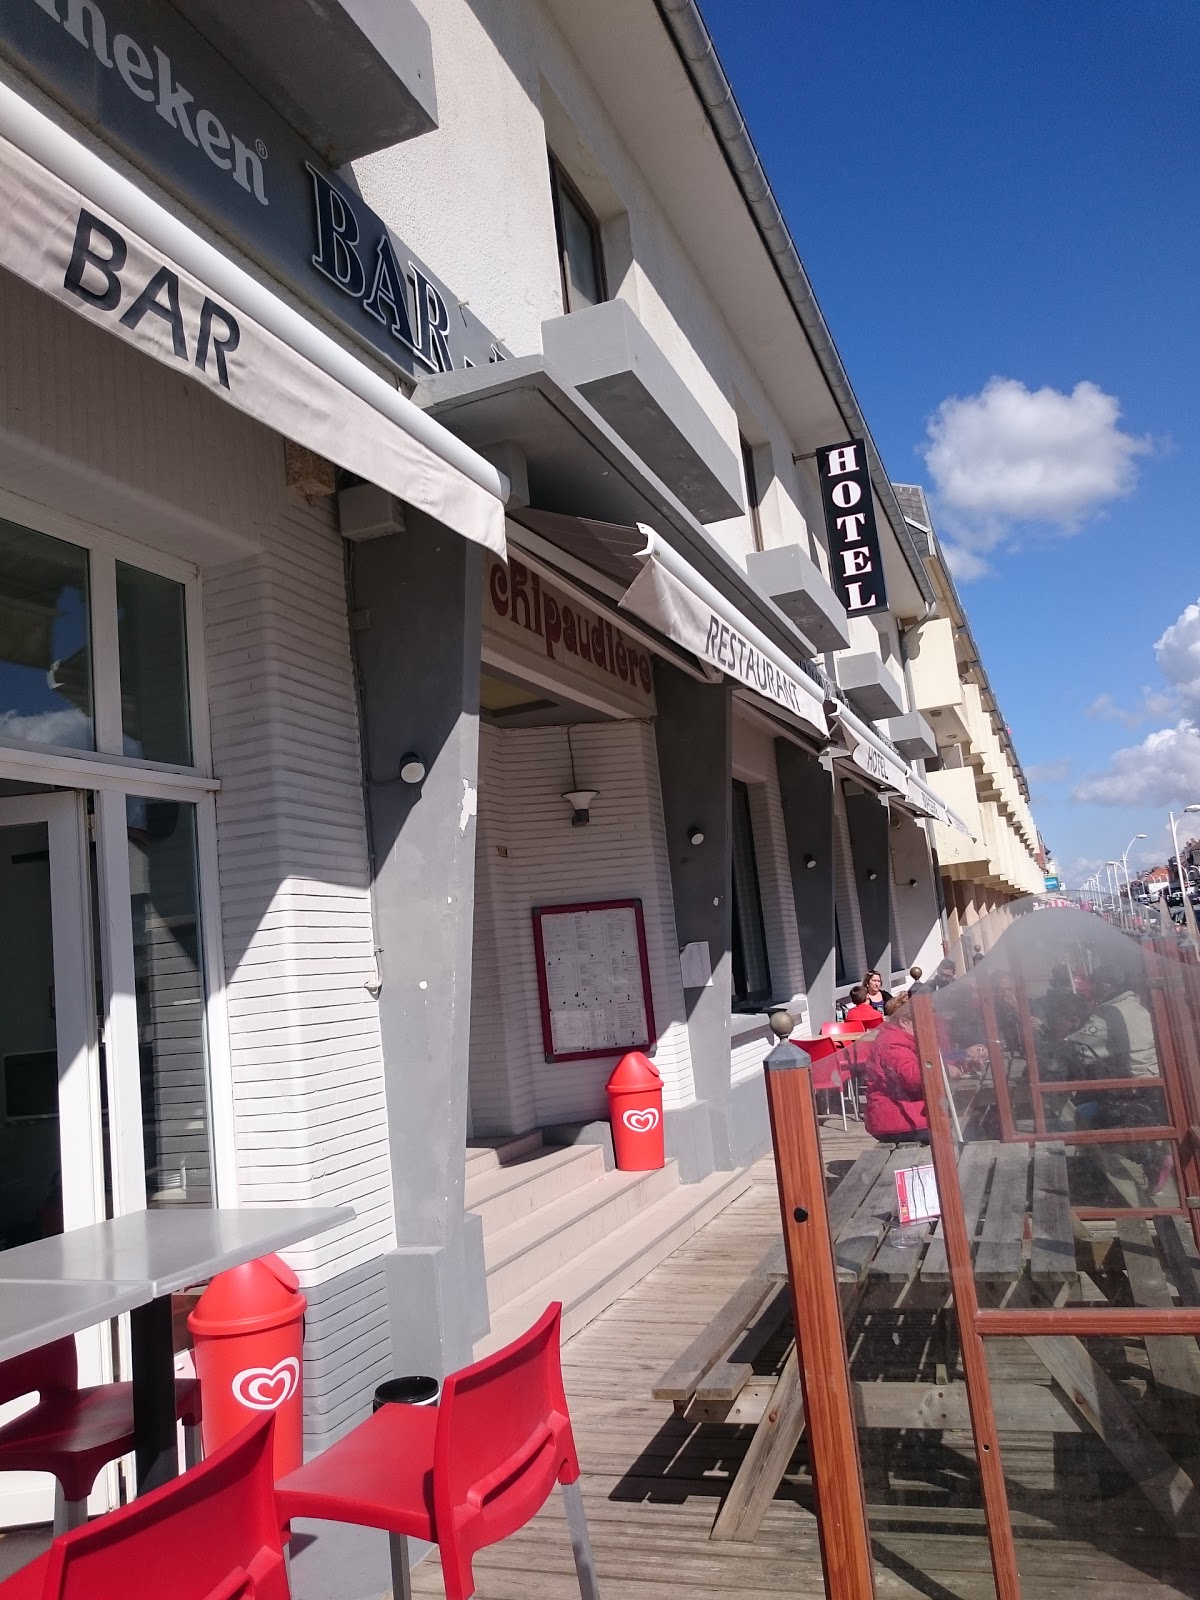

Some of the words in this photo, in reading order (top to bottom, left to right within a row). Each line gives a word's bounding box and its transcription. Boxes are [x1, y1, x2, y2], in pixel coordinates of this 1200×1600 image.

[63, 207, 241, 390] BAR
[305, 160, 455, 373] BAR
[825, 445, 876, 611] HOTEL
[705, 614, 801, 713] RESTAURANT
[867, 746, 889, 780] HOTEL
